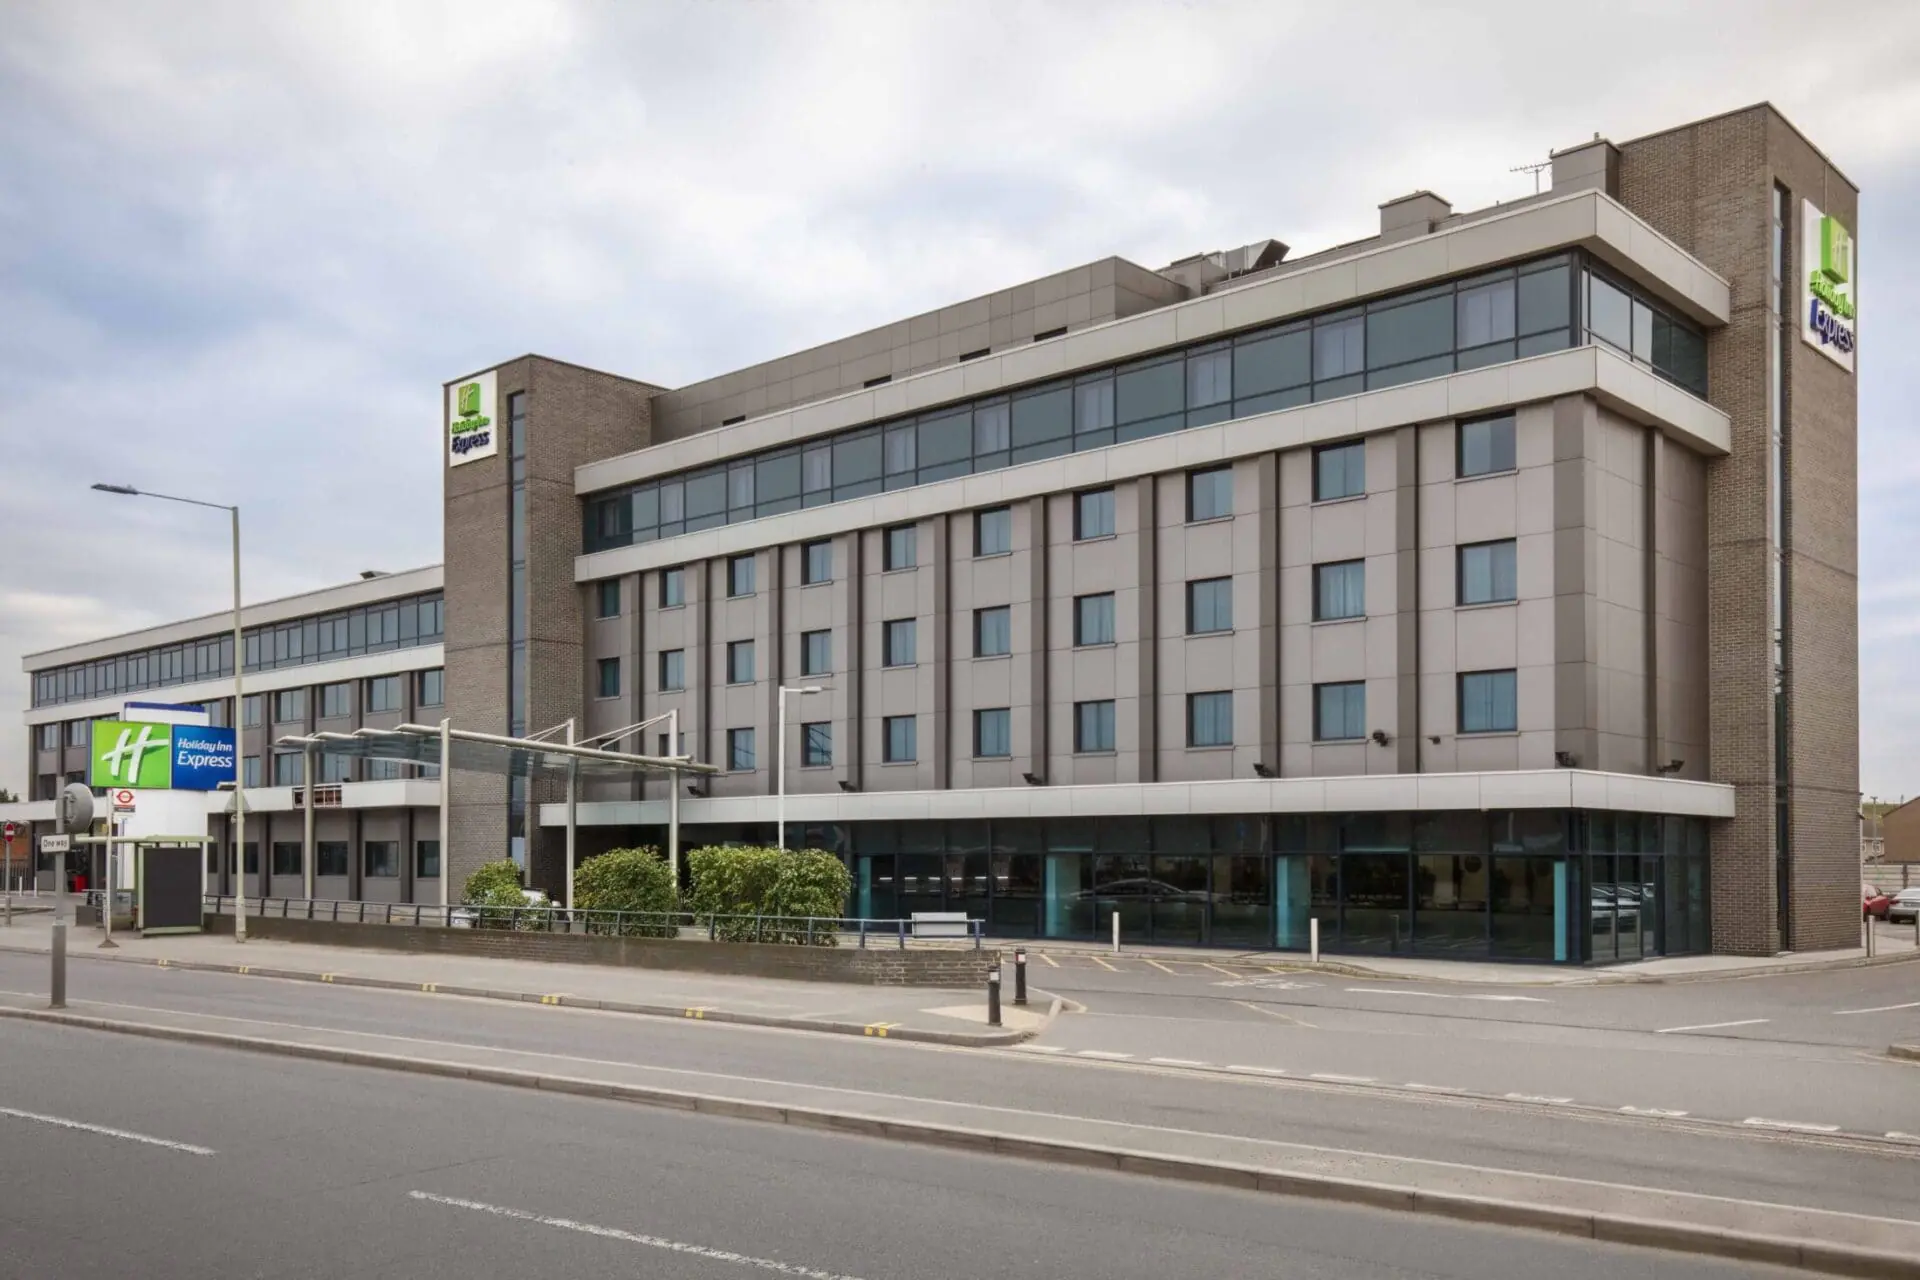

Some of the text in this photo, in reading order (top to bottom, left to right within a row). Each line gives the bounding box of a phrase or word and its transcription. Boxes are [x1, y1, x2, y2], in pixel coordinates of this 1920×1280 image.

[1810, 297, 1854, 353] Express
[452, 432, 489, 453] Express
[177, 737, 233, 752] Holiday Inn
[177, 750, 233, 769] Express
